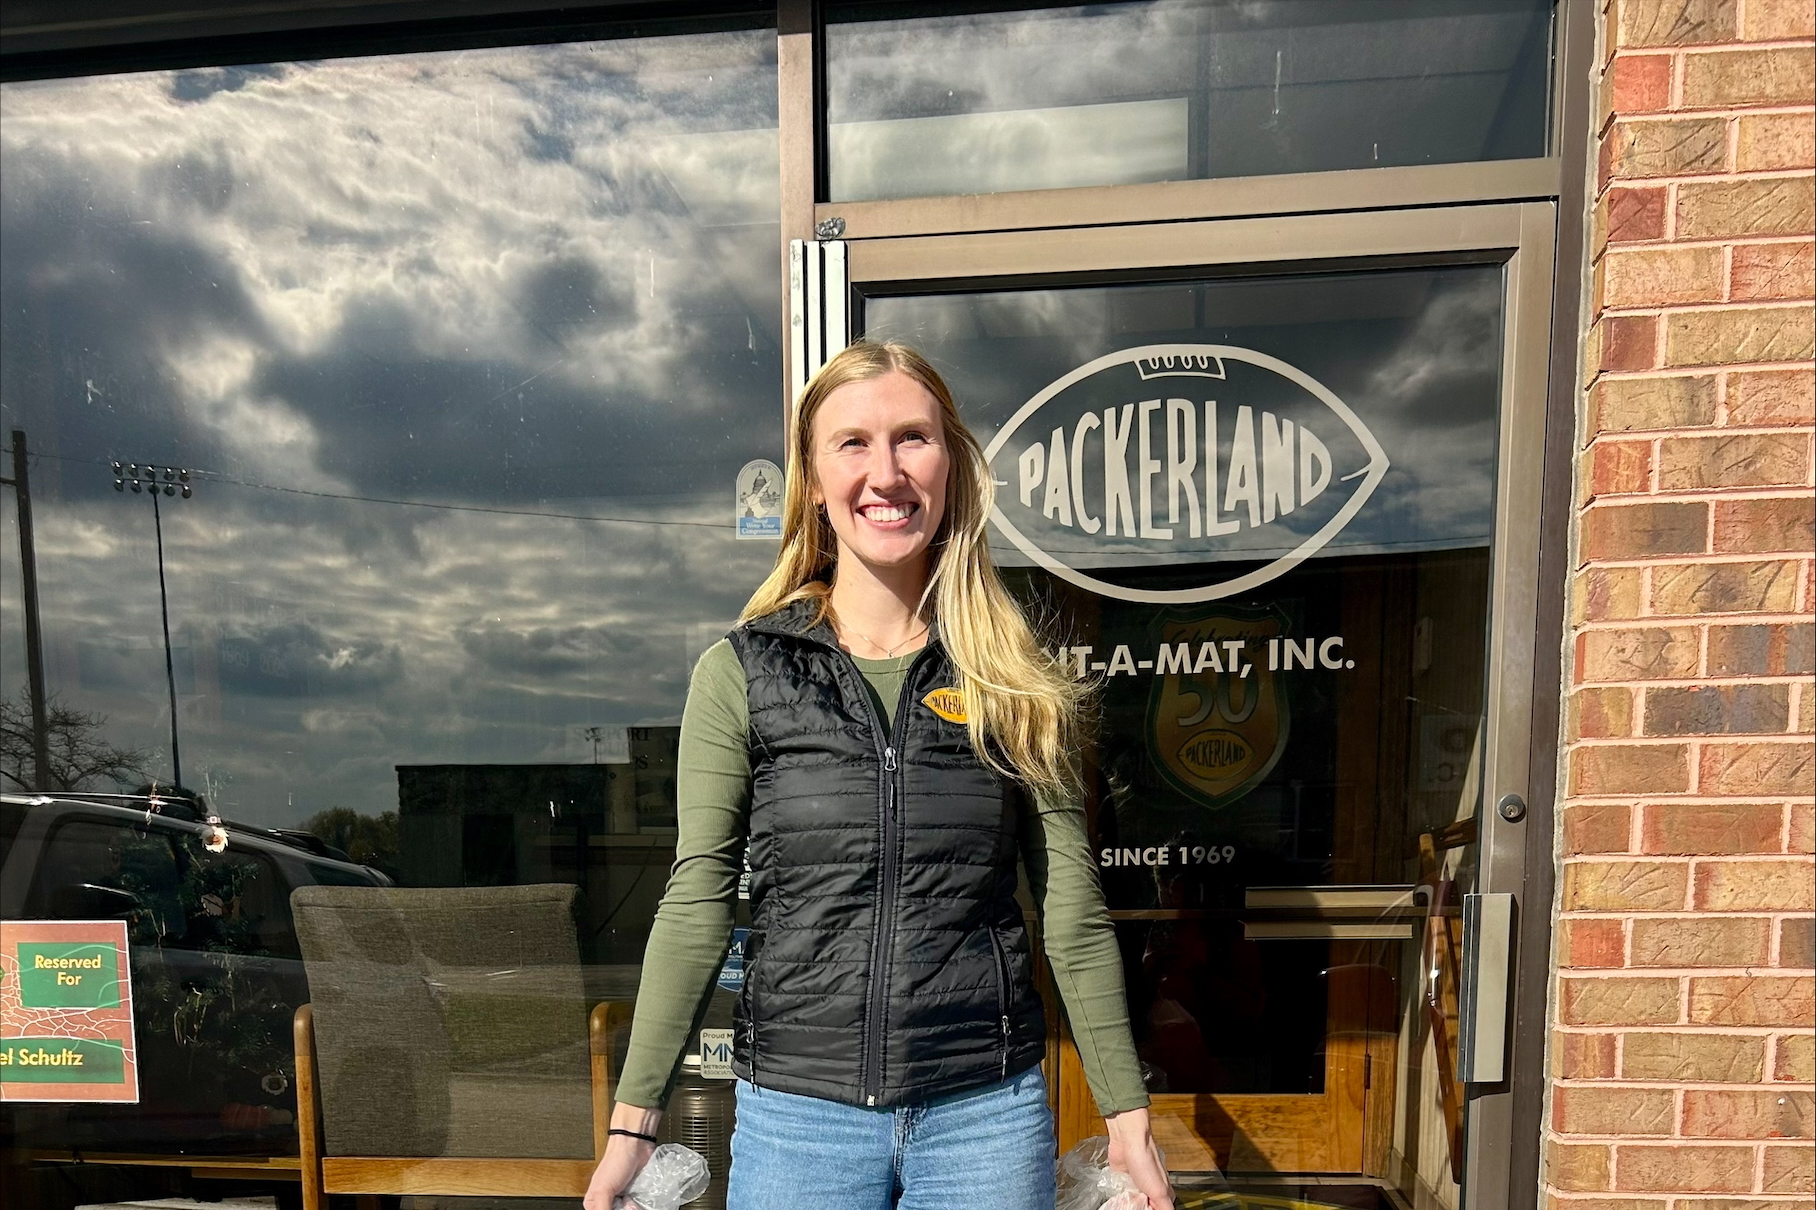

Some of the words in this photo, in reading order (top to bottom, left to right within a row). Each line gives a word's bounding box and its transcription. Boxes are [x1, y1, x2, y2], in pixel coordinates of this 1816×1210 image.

[1019, 398, 1332, 540] PACKERLAND
[1268, 636, 1355, 672] INC.
[1186, 739, 1246, 768] PACKERLAND
[1100, 846, 1170, 867] SINCE
[1179, 845, 1236, 865] 1969
[34, 954, 102, 969] Reserved
[57, 972, 82, 986] For
[703, 1032, 725, 1040] Proud
[18, 1048, 84, 1067] Schultz
